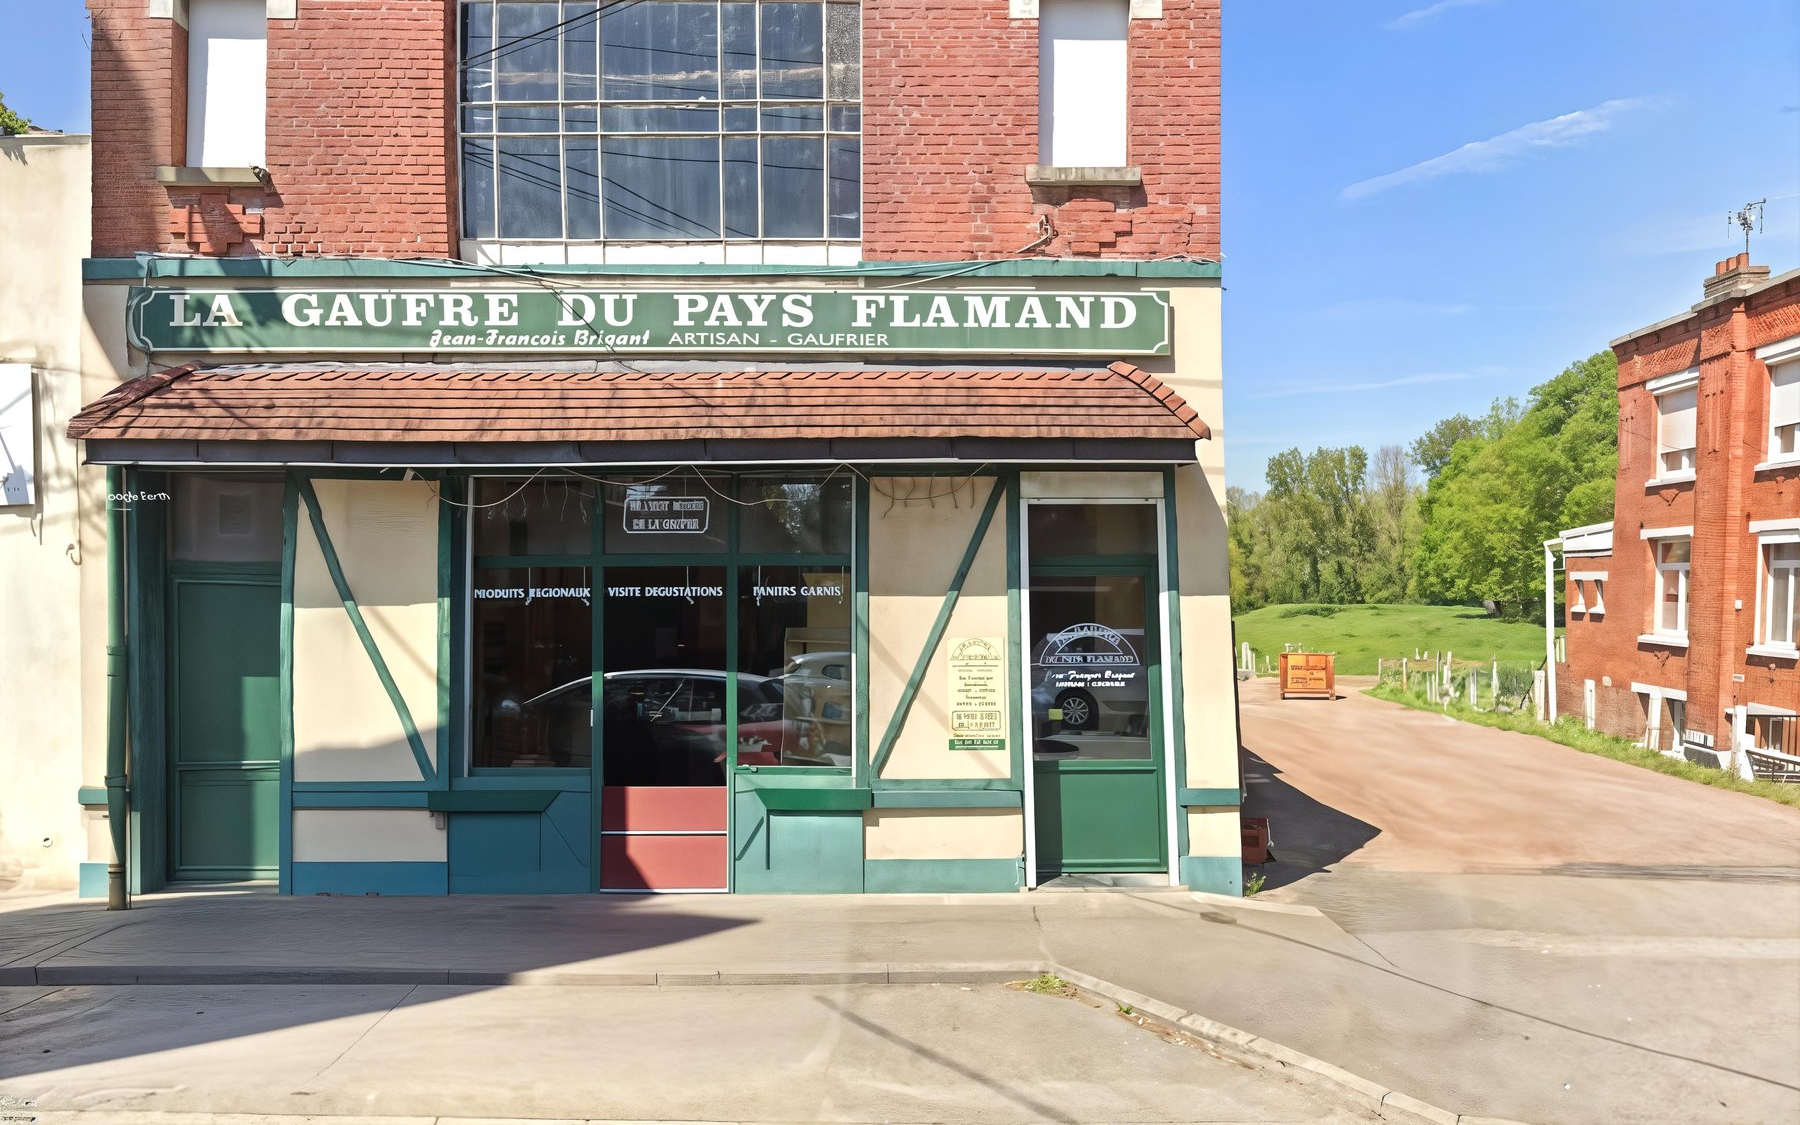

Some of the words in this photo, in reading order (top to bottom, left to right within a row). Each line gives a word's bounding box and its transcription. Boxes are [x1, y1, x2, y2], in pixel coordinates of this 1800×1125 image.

[169, 294, 243, 327] LA
[281, 293, 519, 327] GAUFRE
[557, 294, 638, 327] DU
[673, 294, 814, 328] PAYS
[851, 295, 1137, 329] FLAMAND
[574, 329, 650, 348] Brigant
[668, 332, 760, 346] ARTISAN
[787, 333, 889, 347] GAUFRIER
[607, 586, 641, 597] VISITE
[645, 586, 723, 597] DEGUSTATIONS
[800, 585, 841, 596] GARNIS
